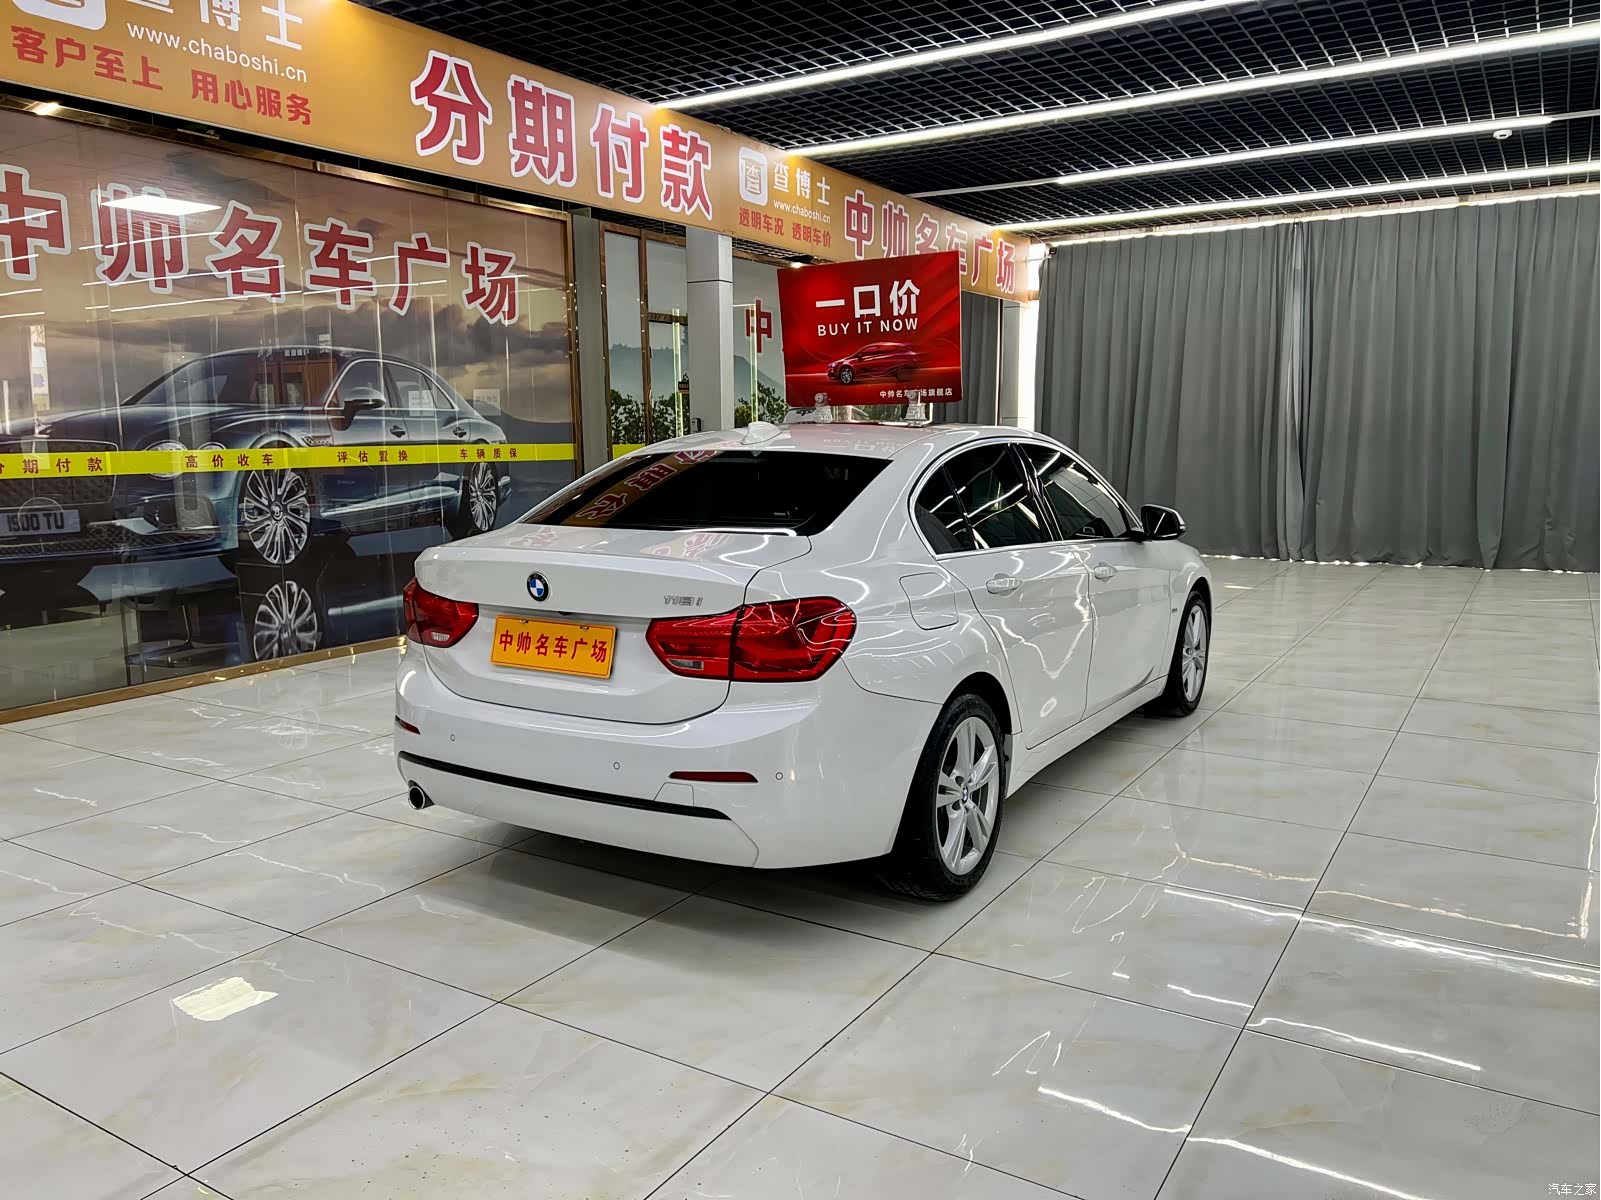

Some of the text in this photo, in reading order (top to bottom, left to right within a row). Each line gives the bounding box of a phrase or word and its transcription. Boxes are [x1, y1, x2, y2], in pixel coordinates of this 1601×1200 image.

[127, 22, 308, 84] www.chaboshi.cn
[11, 25, 312, 126] 客户至上 用心服务
[411, 51, 712, 221] 分期付款
[773, 160, 831, 206] 查博士
[739, 207, 832, 248] 透明车况 透明车价
[773, 199, 831, 224] www.chaboshi.cn
[0, 164, 524, 325] 中帅名车广场
[815, 279, 921, 318] 一口价
[745, 299, 773, 353] 中
[817, 318, 918, 336] BUY IT NOW
[185, 453, 274, 469] 高价收车
[337, 449, 408, 464] 评估置换
[499, 629, 608, 664] 中帅名车广场
